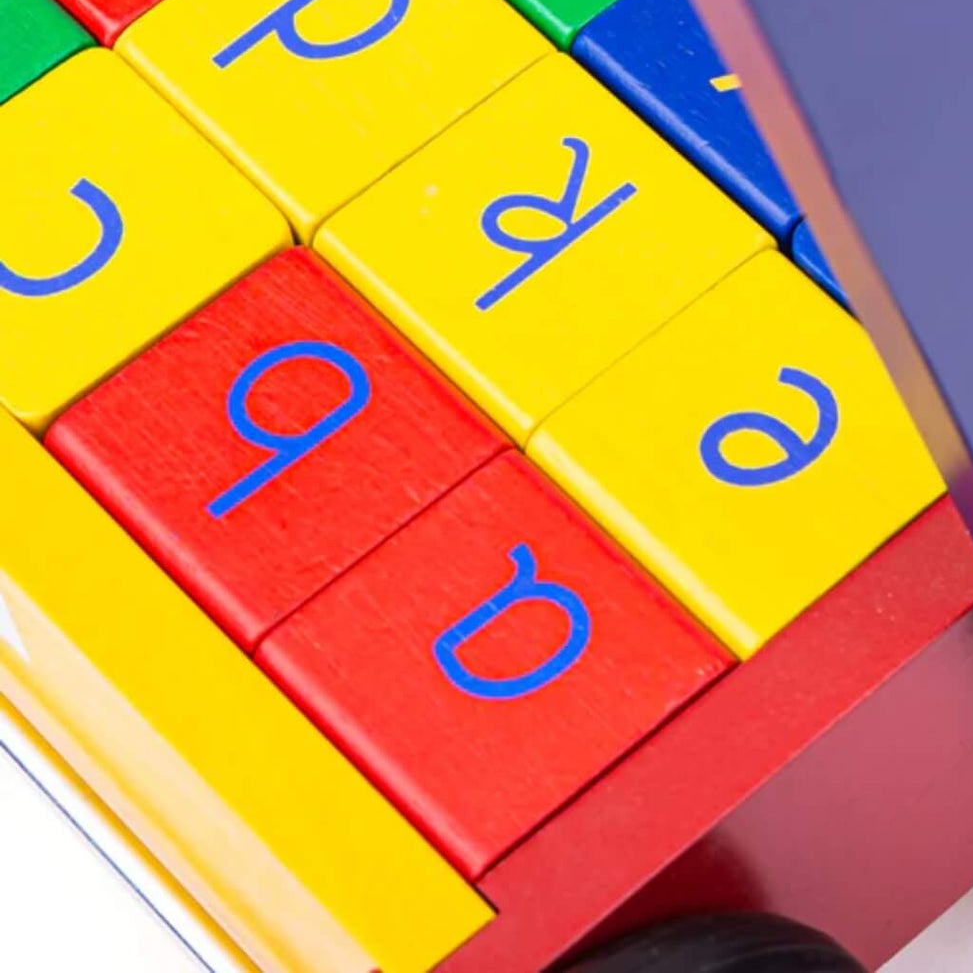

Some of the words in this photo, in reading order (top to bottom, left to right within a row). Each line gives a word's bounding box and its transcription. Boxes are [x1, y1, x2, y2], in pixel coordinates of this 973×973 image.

[475, 137, 637, 311] k
[206, 340, 371, 519] b
[699, 367, 839, 486] e
[433, 543, 591, 700] a
